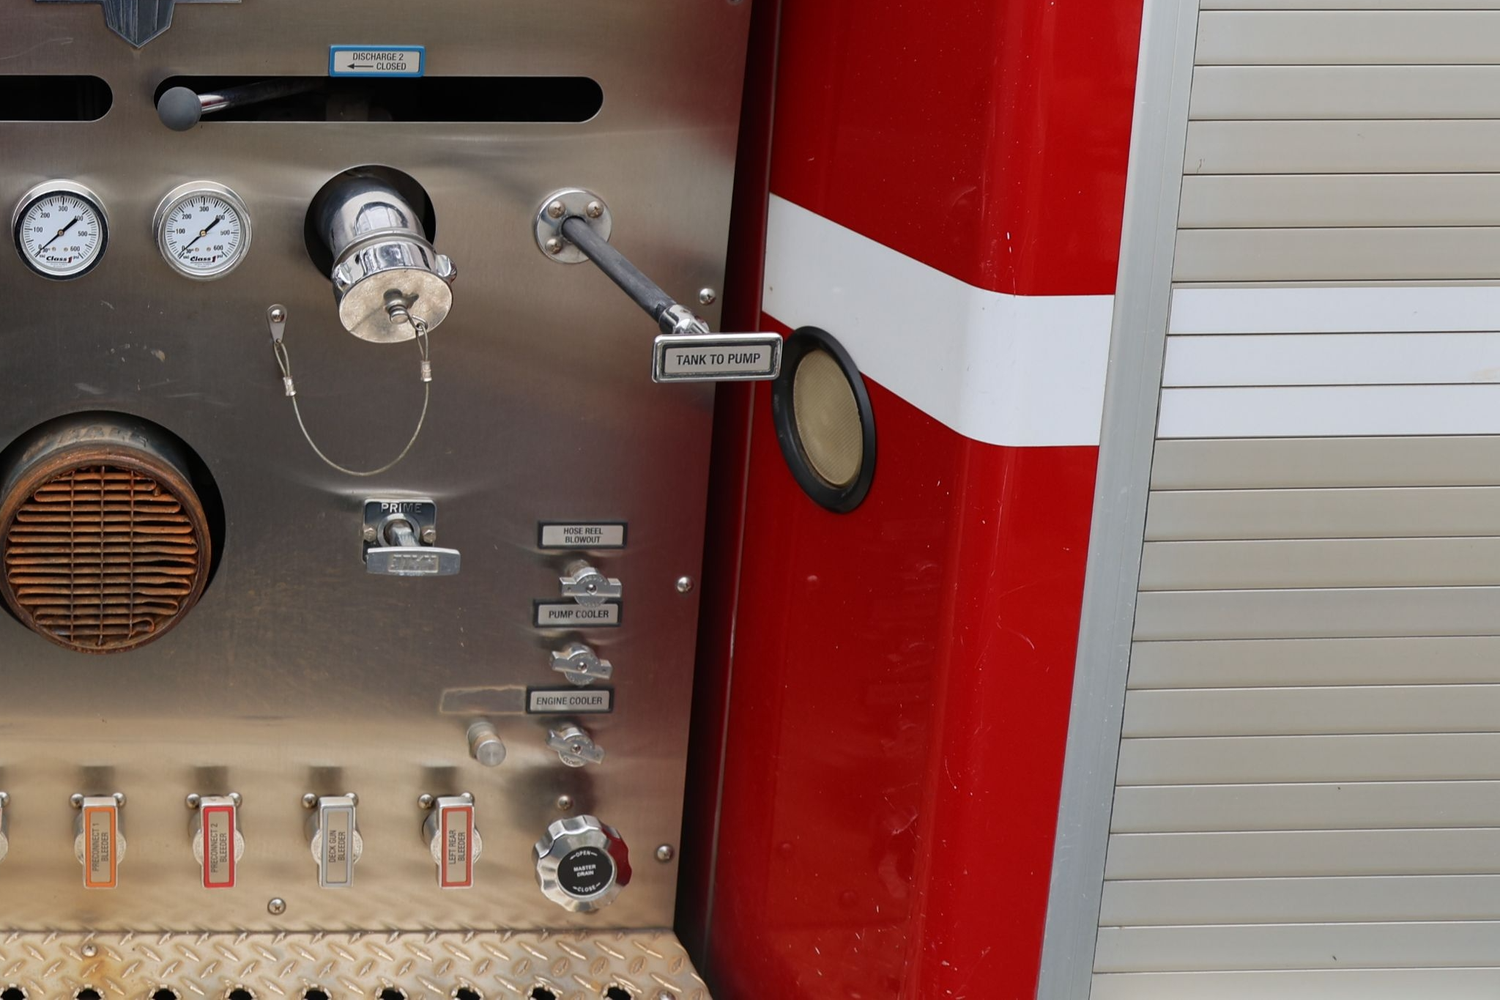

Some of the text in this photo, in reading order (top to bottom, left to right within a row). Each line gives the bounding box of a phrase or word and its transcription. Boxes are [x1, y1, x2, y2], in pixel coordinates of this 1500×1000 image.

[352, 52, 396, 62] DISCHARGE
[375, 62, 407, 71] CLOSED
[676, 353, 760, 365] TANK TO PUMP
[381, 503, 422, 513] PRIME
[563, 527, 603, 535] HOSE REEL
[565, 536, 601, 544] BLOWOUT
[549, 610, 609, 619] PUMP COOLER
[536, 697, 603, 705] ENGINE COOLER
[101, 832, 109, 862] BLEEDER
[575, 850, 591, 858] OPEN
[573, 864, 596, 872] MASTER
[577, 885, 596, 893] CLOSE
